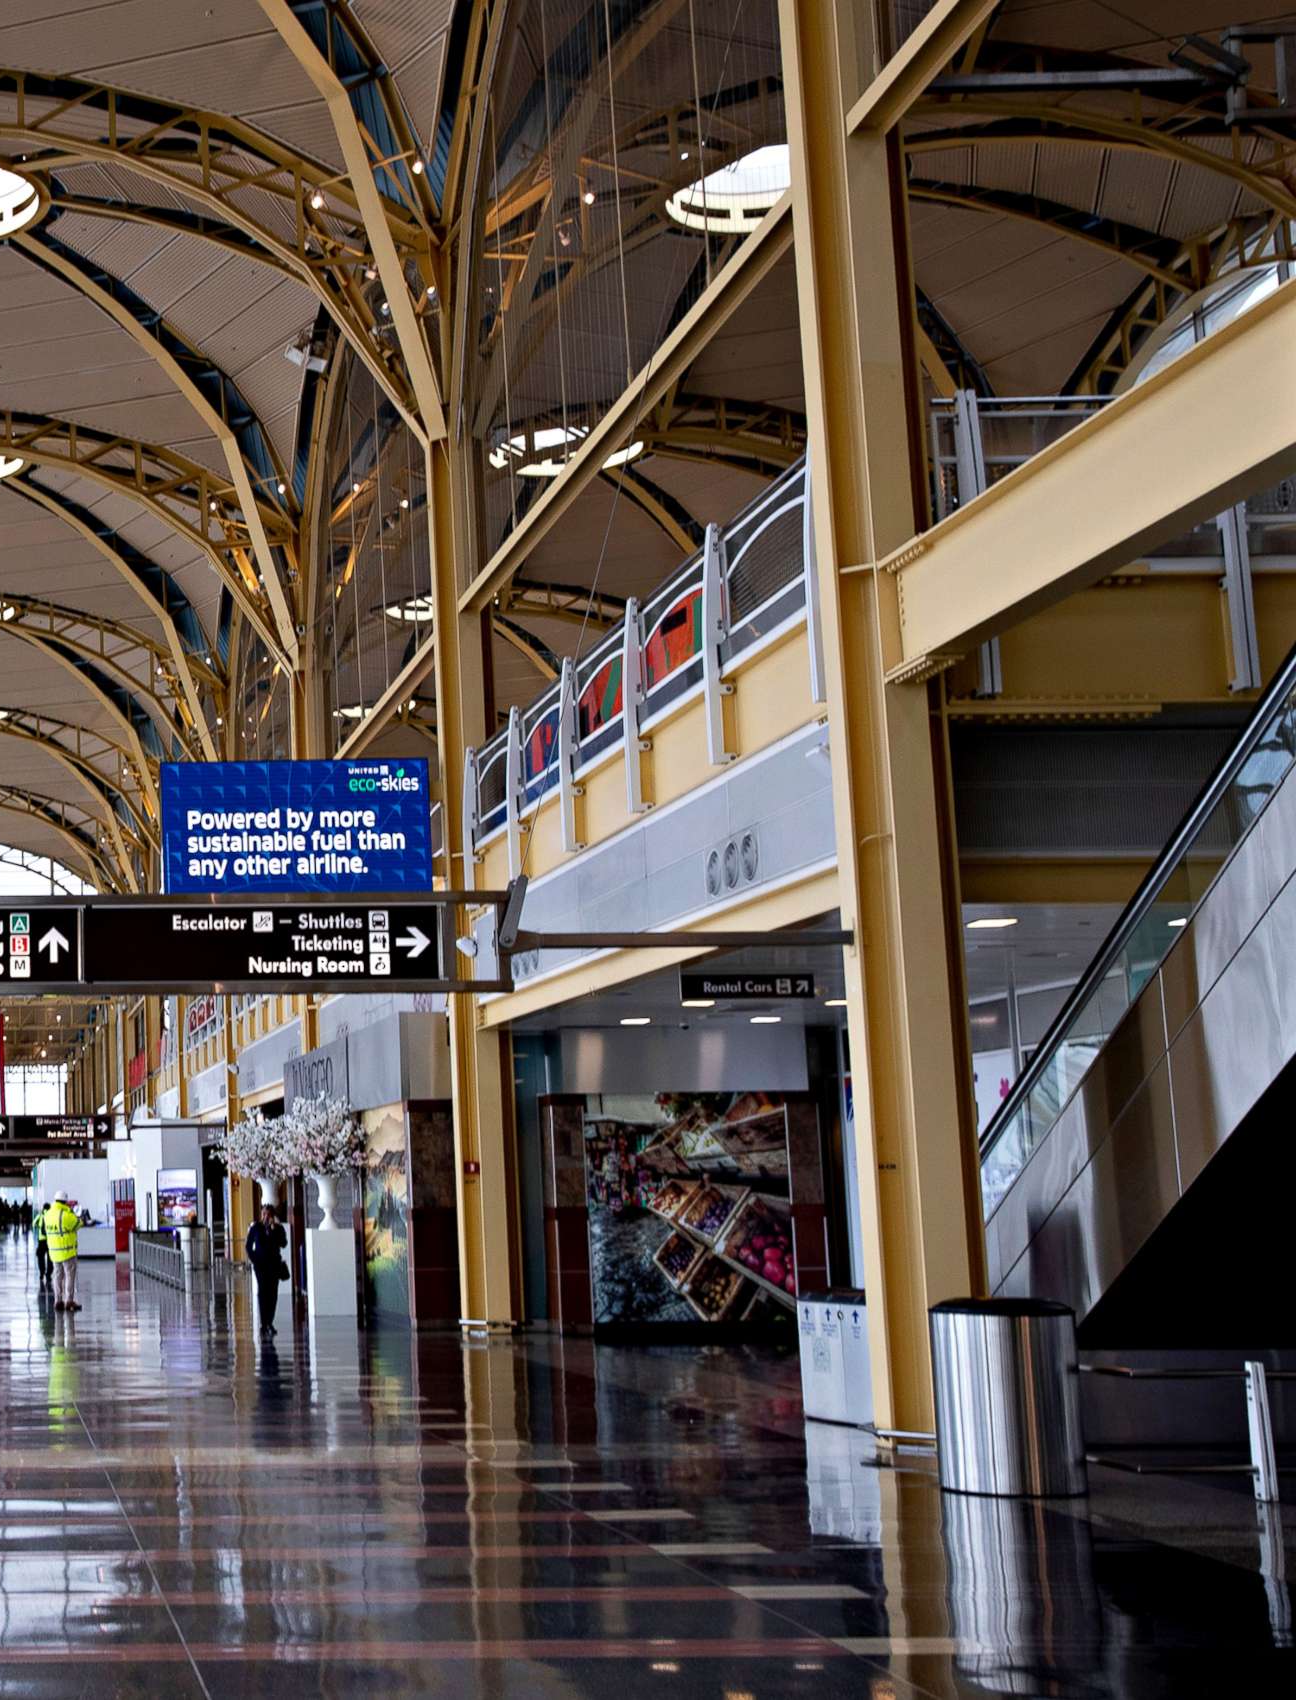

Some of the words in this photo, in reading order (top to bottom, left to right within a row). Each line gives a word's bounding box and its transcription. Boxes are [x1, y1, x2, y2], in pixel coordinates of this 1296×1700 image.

[348, 767, 379, 775] UNITED
[348, 772, 420, 793] eco-skies
[187, 809, 281, 831] Powered
[286, 808, 313, 832] by
[319, 809, 376, 829] more
[187, 831, 307, 854] sustainable
[310, 830, 352, 852] fuel
[357, 829, 406, 851] than
[188, 859, 228, 880] any
[233, 854, 291, 876] other
[296, 854, 369, 875] airline.
[172, 913, 248, 931] Escalator
[298, 913, 364, 930] Shuttles
[291, 935, 364, 955] Ticketing
[248, 957, 313, 978] Nursing
[316, 956, 365, 975] Room
[703, 981, 742, 993] Rental
[745, 981, 773, 993] Cars
